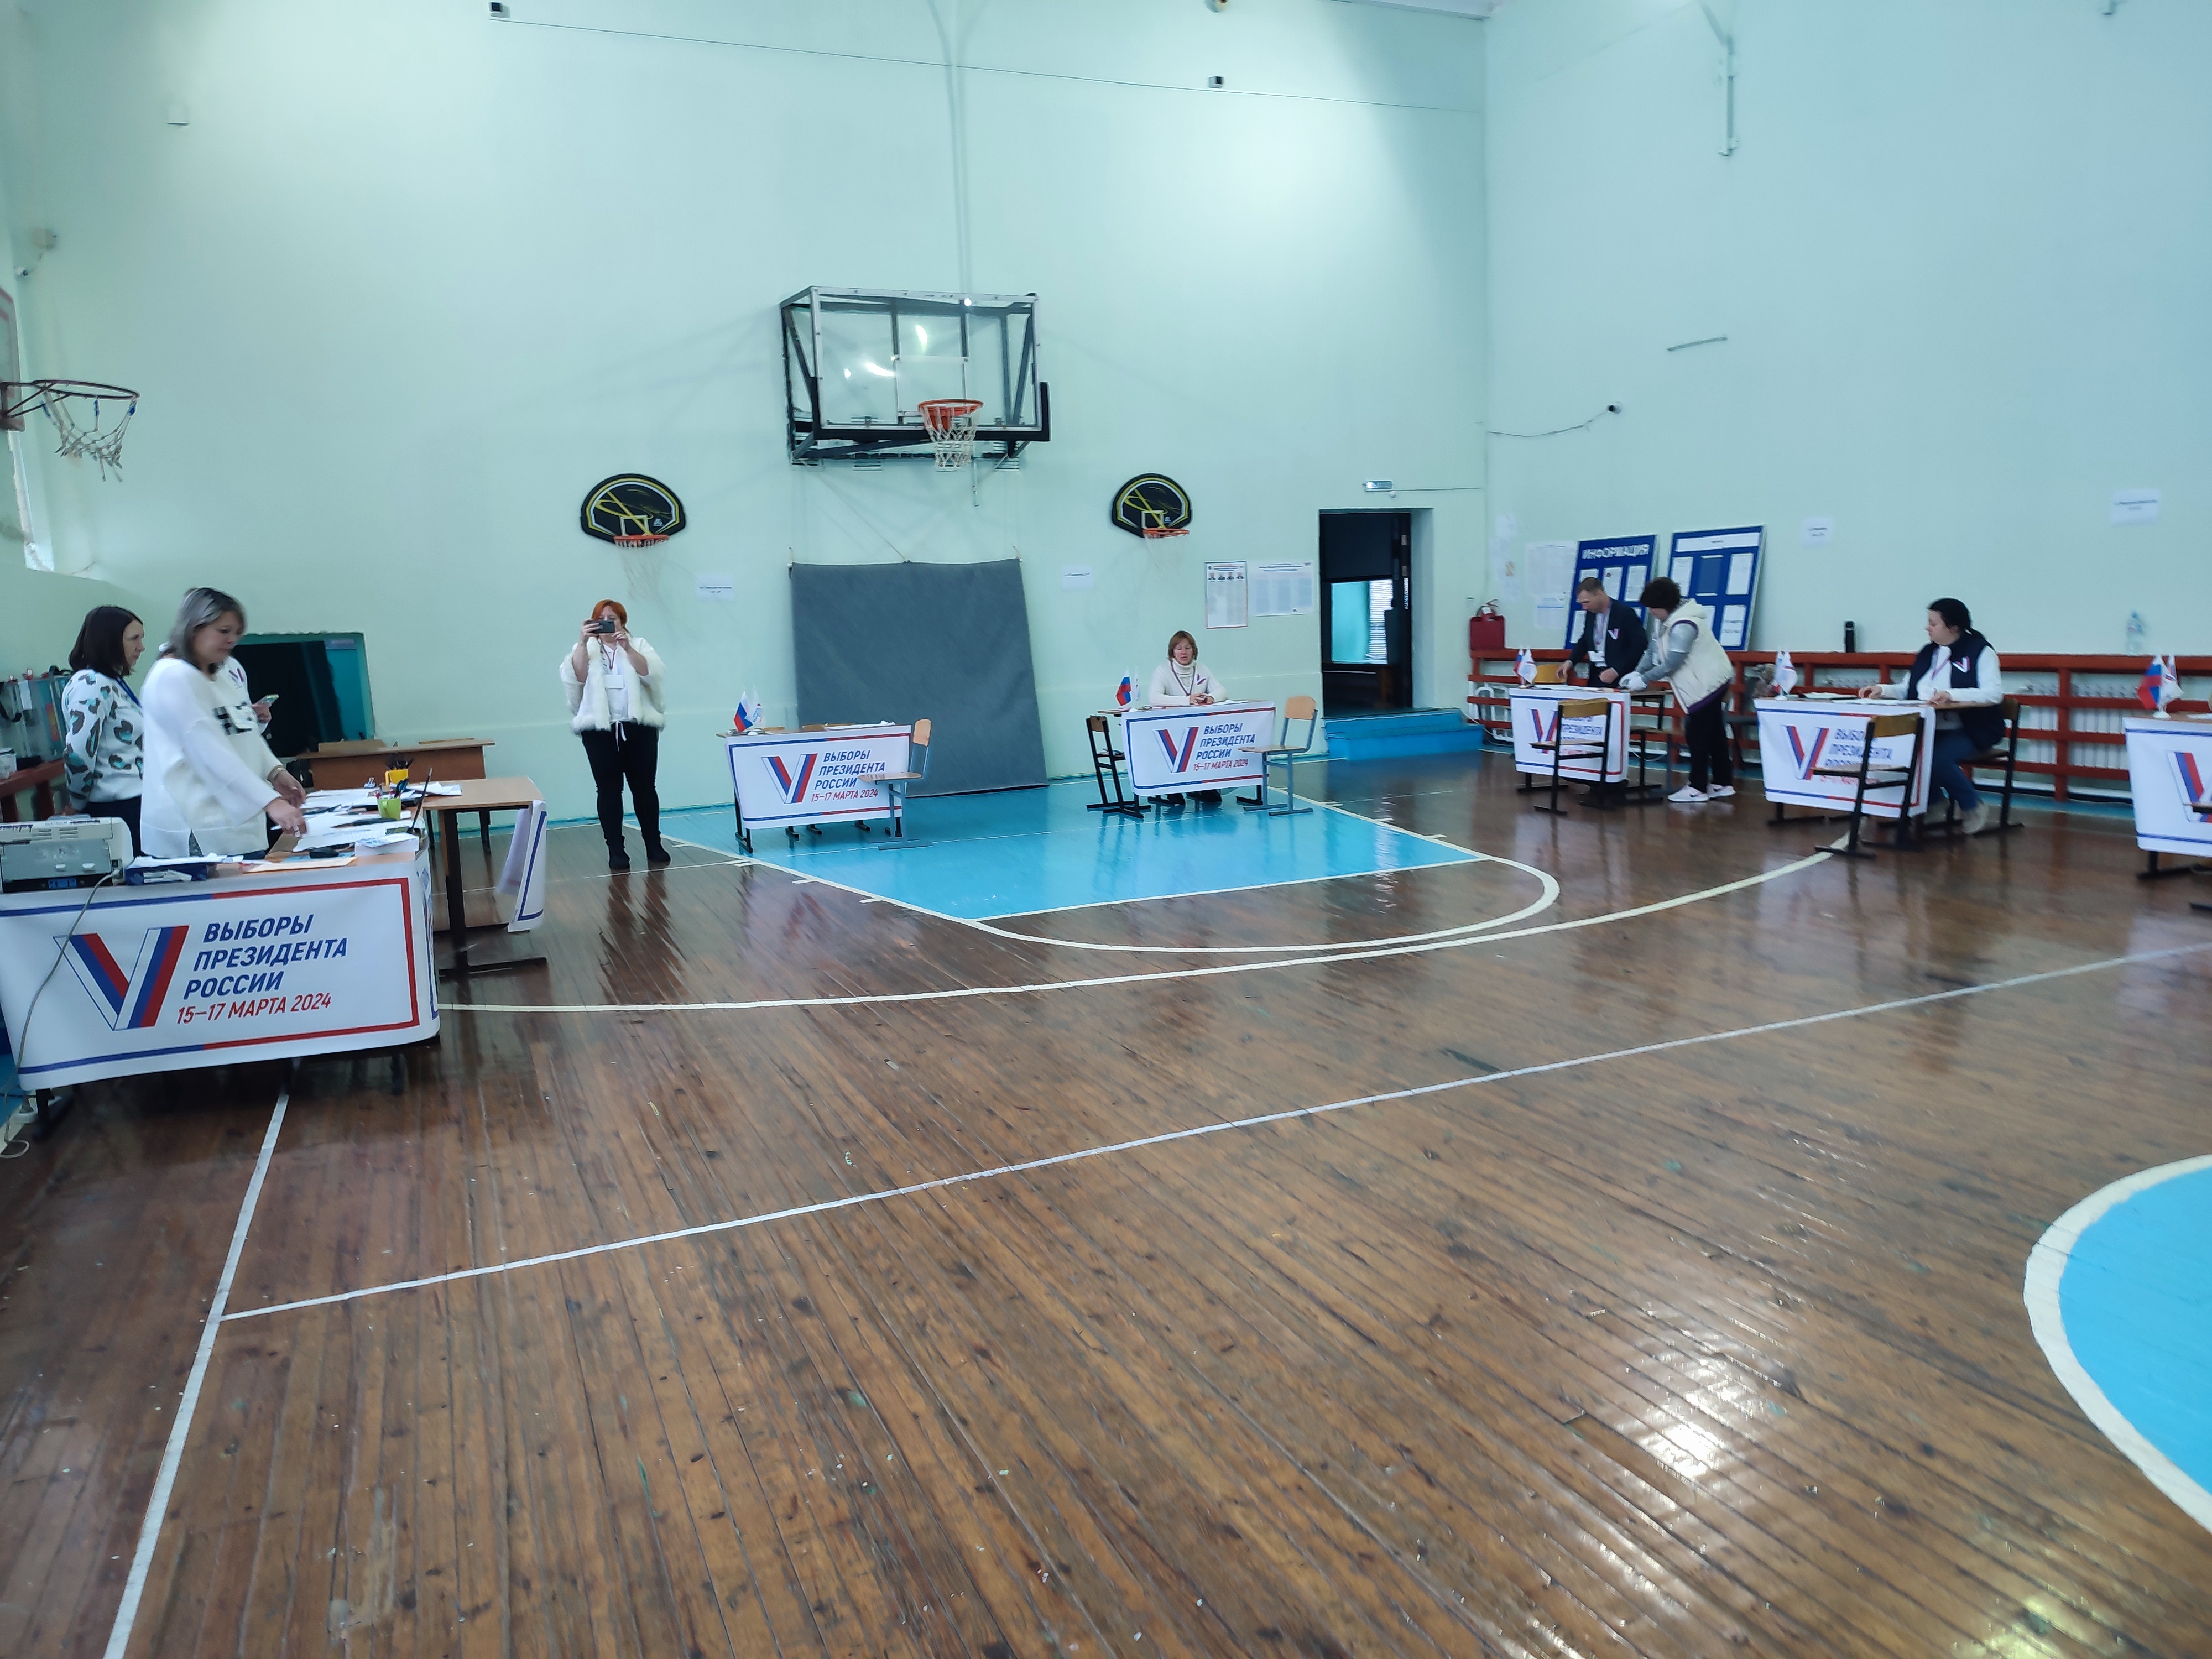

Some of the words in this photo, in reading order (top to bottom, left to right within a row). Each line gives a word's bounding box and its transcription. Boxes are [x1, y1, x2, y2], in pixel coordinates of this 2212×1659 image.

[1203, 723, 1243, 735] ВЫБОРЫ
[1199, 734, 1255, 748] ПРЕЗИДЕНТА
[823, 749, 871, 763] ВЫБОРЫ
[1196, 748, 1232, 760] РОССИИ
[818, 762, 885, 776] ПРЕЗИДЕНТА
[1211, 760, 1232, 769] МАРТА
[814, 778, 857, 790] РОССИИ
[833, 790, 858, 801] МАРТА
[859, 789, 878, 798] 2024
[202, 914, 314, 943] ВЫБОРЫ
[192, 938, 347, 972] ПРЕЗИДЕНТА
[183, 971, 284, 1000] РОССИИ
[227, 997, 287, 1020] МАРТА
[290, 992, 332, 1013] 2024
